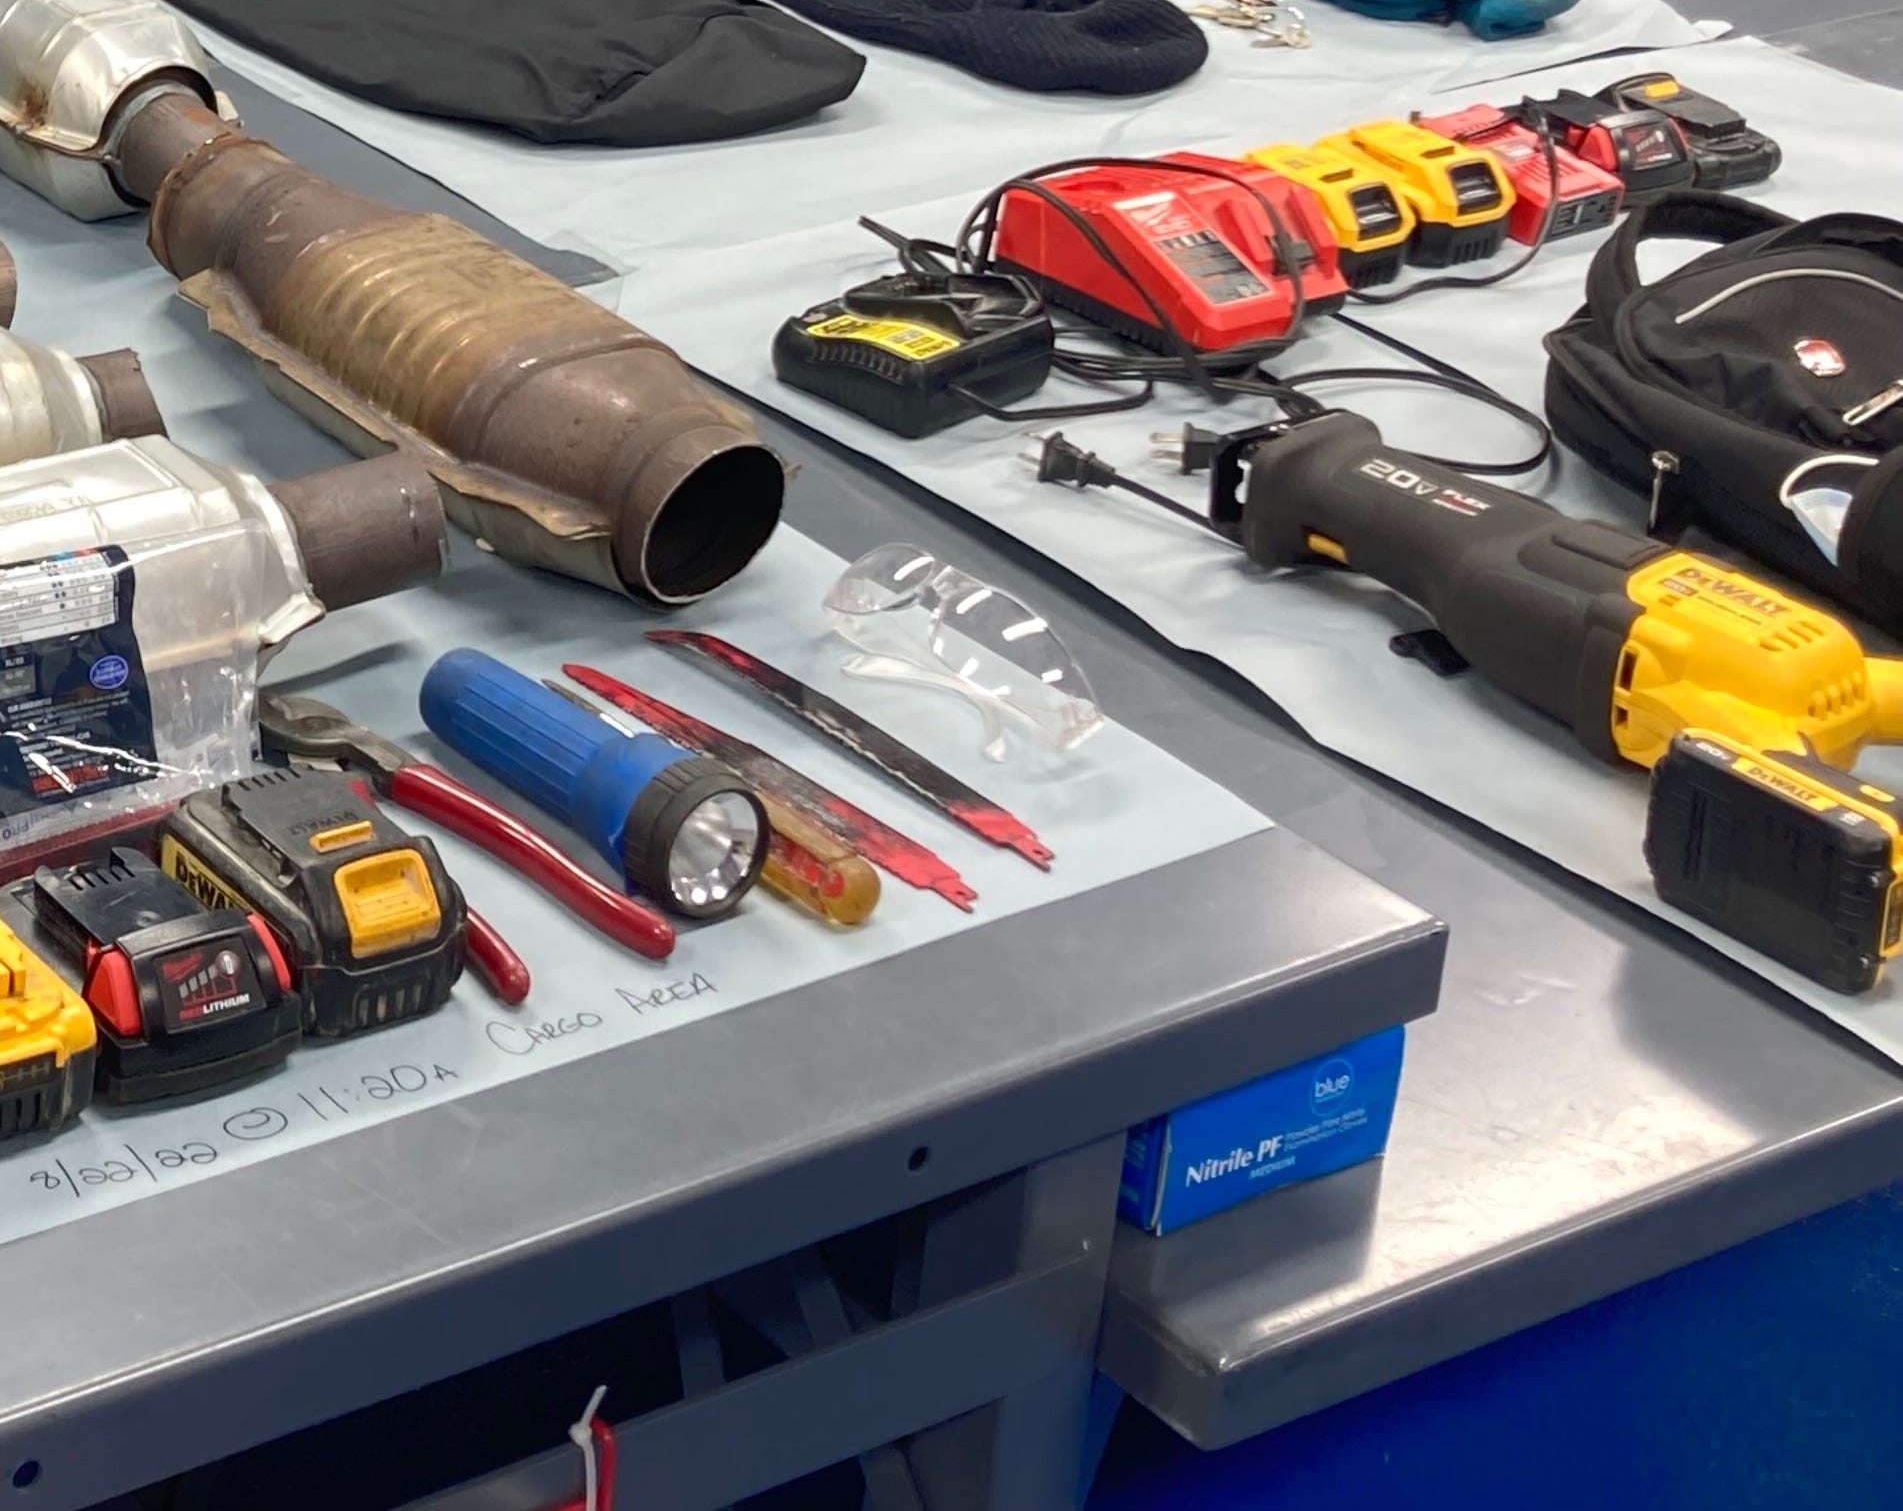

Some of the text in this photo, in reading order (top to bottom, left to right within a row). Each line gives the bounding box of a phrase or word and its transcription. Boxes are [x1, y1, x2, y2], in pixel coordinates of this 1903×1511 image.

[1359, 457, 1439, 497] 20V
[1747, 766, 1820, 802] DEWALT
[174, 848, 236, 910] DEWA
[614, 971, 720, 1015] AREA
[1314, 1074, 1351, 1099] blue
[1184, 1134, 1285, 1188] Nitrile PF
